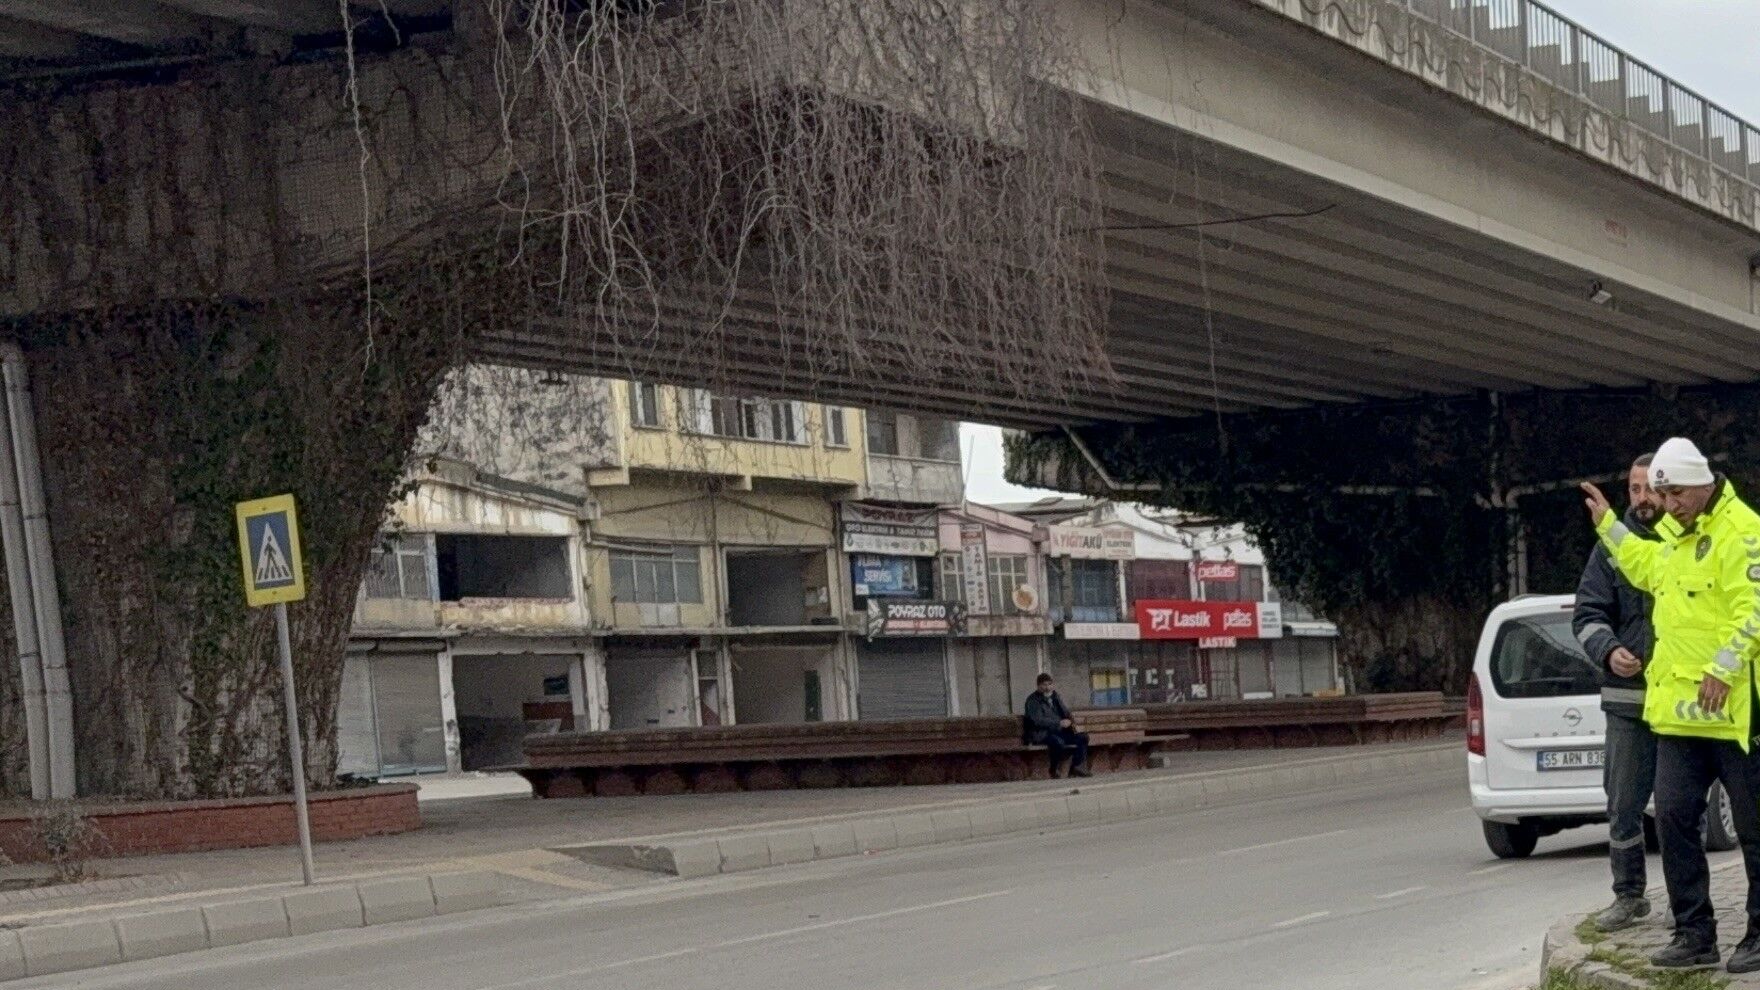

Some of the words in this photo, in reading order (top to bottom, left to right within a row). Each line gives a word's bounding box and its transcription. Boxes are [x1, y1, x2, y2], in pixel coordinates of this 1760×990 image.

[927, 605, 946, 617] OTO
[1174, 610, 1211, 627] Lastik
[1545, 753, 1557, 766] 55
[1563, 752, 1582, 765] ARN
